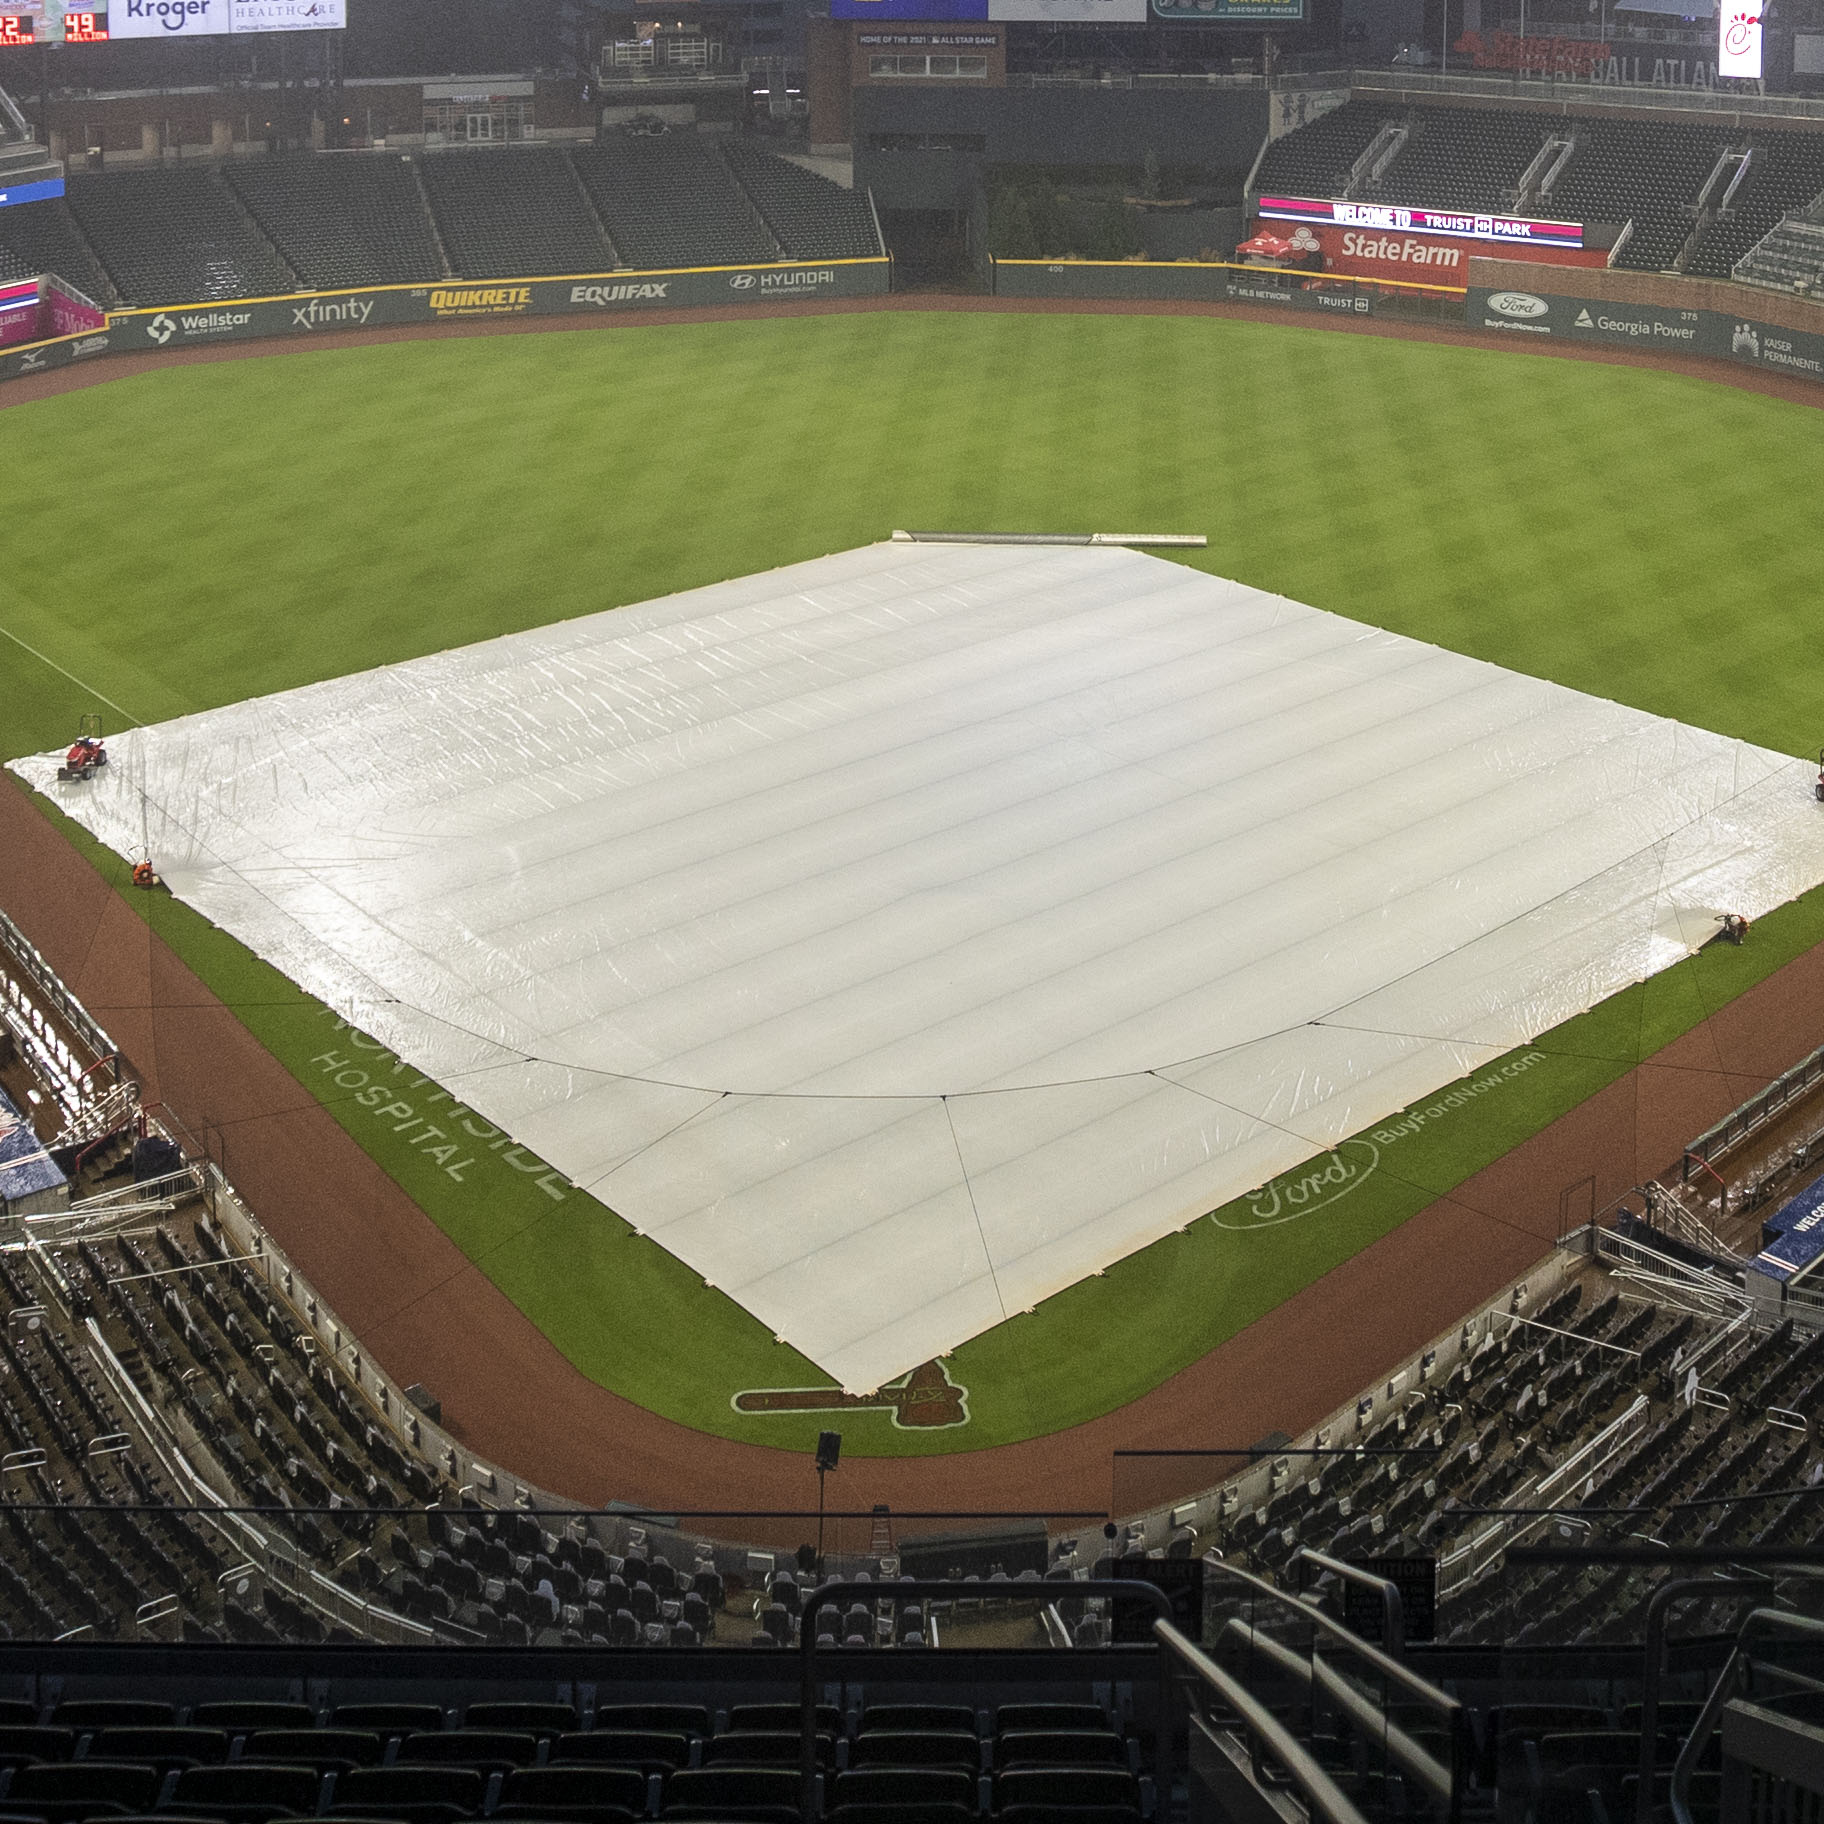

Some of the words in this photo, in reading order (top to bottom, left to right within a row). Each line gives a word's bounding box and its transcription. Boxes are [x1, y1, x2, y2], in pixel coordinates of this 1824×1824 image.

[235, 3, 336, 18] HEALTHCARE
[64, 13, 95, 33] 49
[1332, 203, 1394, 227] WELCOME
[1394, 209, 1412, 227] TO
[1424, 214, 1474, 231] TRUIST
[1493, 221, 1532, 237] PARK
[760, 271, 834, 286] HYUNDAI
[429, 287, 531, 309] QUIKRETE
[570, 282, 667, 305] EQUIFAX
[1317, 295, 1353, 309] TRUIST
[292, 297, 374, 329] xfinity
[1499, 295, 1537, 314] Ford
[180, 312, 251, 330] Wellstar
[1680, 312, 1698, 321] 375
[1597, 316, 1650, 336] Georgia
[1653, 321, 1696, 340] Power
[1764, 337, 1793, 353] KAISER
[1764, 349, 1821, 372] PERMANENTE
[1371, 1048, 1547, 1146] BuyFordNow.com
[309, 1048, 476, 1183] HOSPITAL
[1244, 1155, 1357, 1220] Ford
[1362, 1560, 1426, 1578] AUTION
